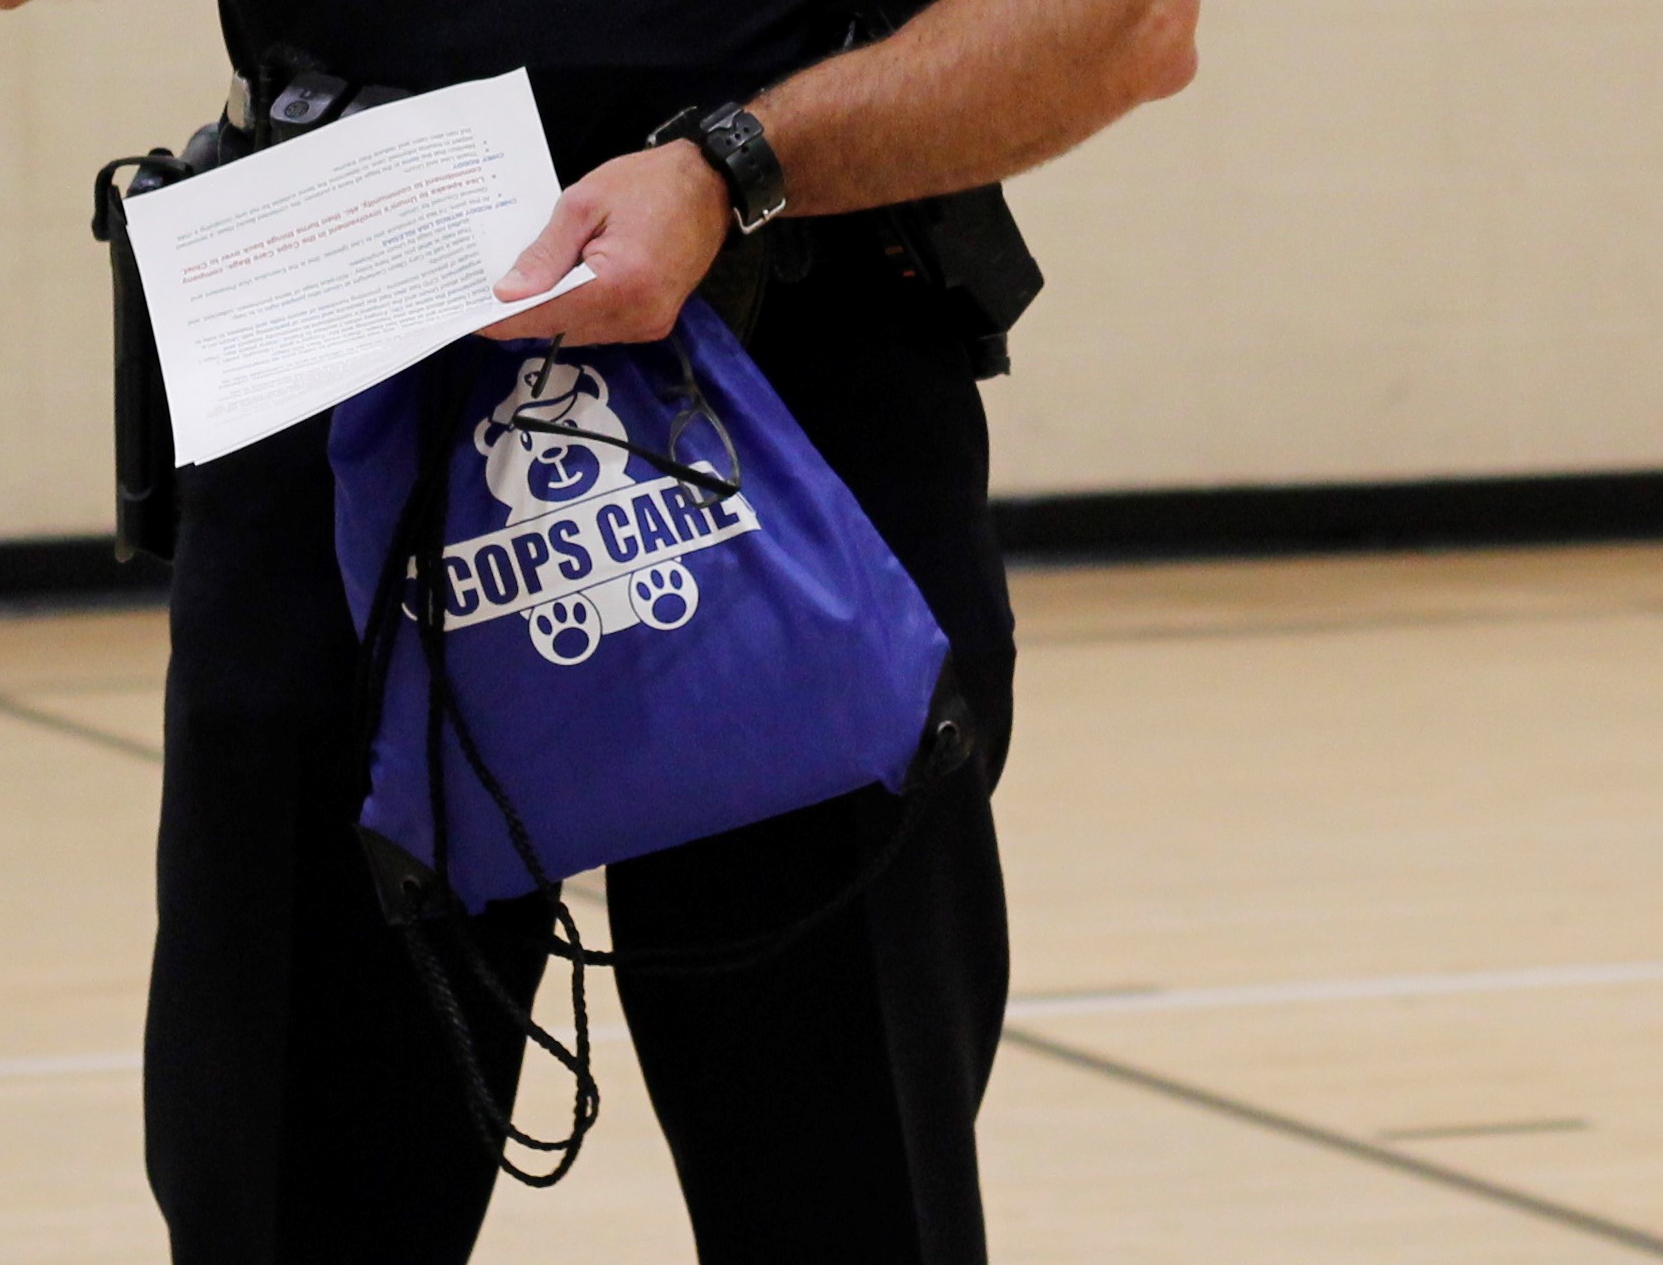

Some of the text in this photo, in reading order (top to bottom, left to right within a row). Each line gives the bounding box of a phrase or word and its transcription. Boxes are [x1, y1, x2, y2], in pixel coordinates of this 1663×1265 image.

[424, 165, 482, 185] commitment
[464, 175, 485, 186] Lisa
[430, 181, 463, 196] speaks
[383, 195, 417, 213] Unum's
[321, 212, 341, 225] then
[327, 208, 382, 235] involvement
[295, 220, 319, 235] turns
[266, 230, 294, 246] things
[301, 234, 316, 245] the
[243, 241, 264, 254] back
[276, 240, 300, 254] Cops
[220, 249, 241, 262] over
[252, 249, 274, 262] Care
[181, 266, 223, 285] company
[442, 518, 593, 617] COPS
